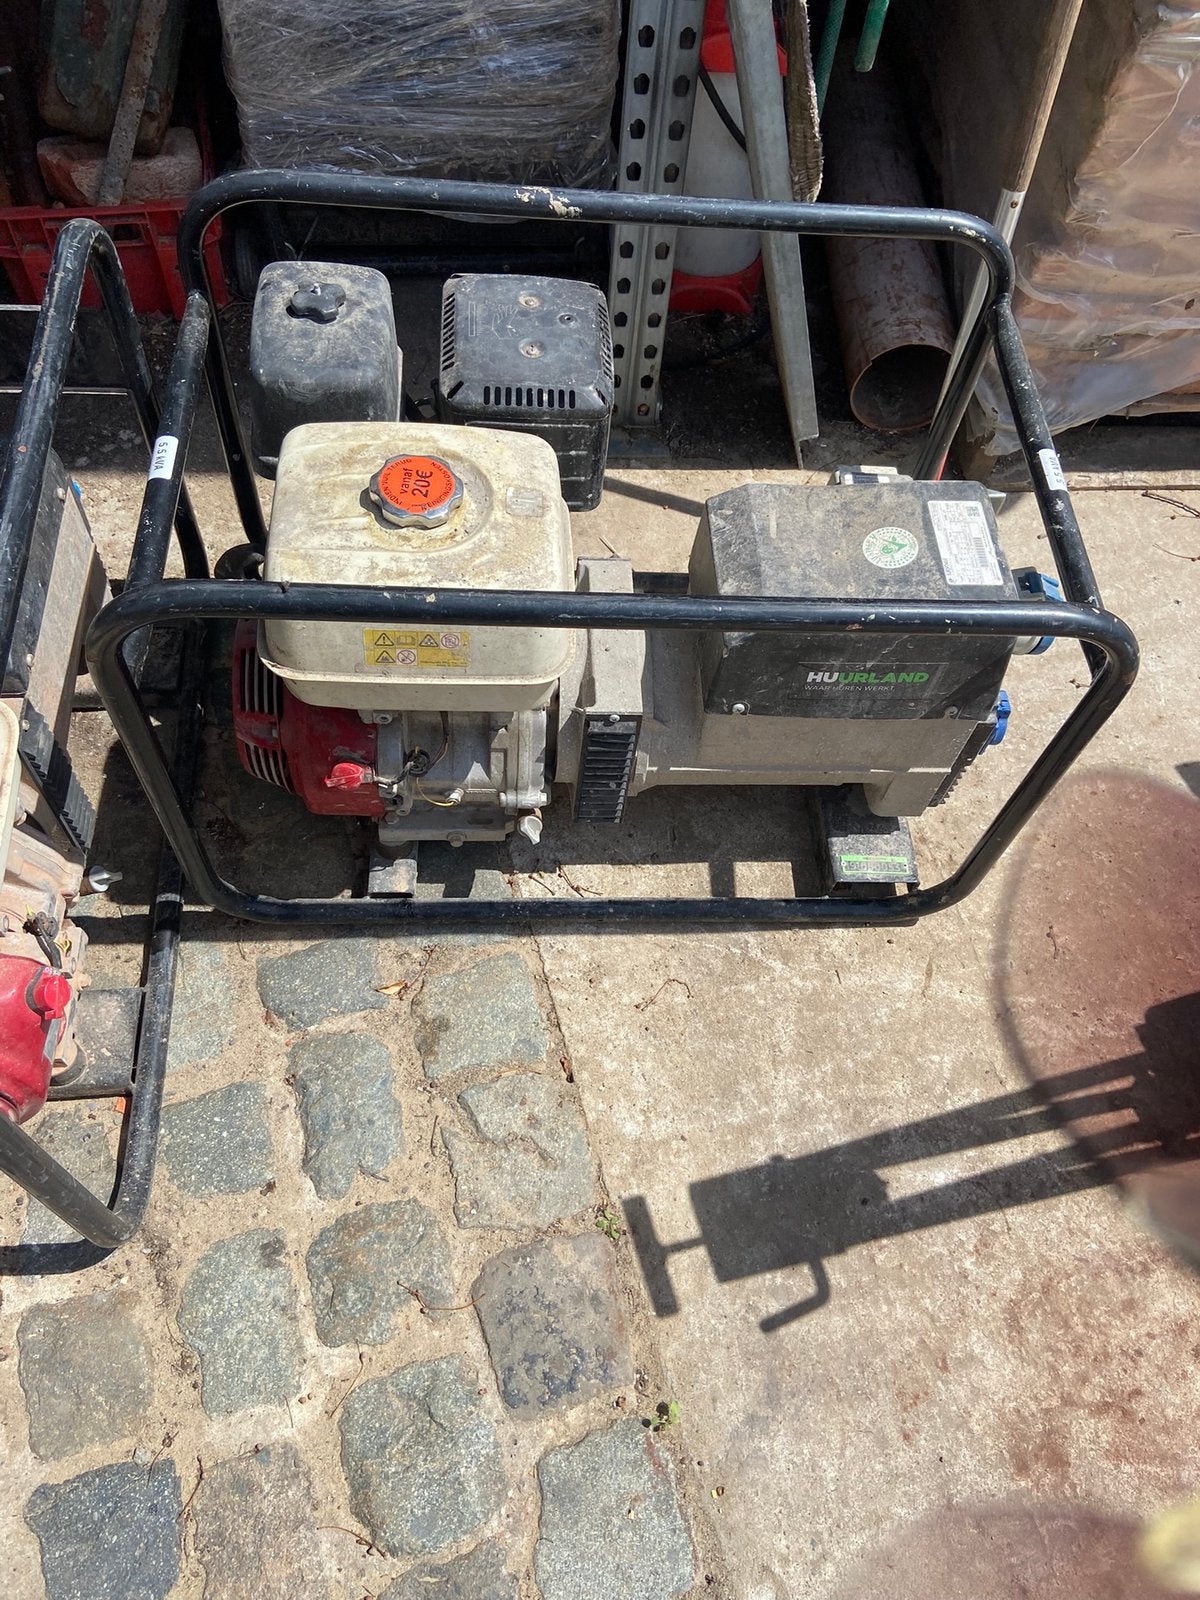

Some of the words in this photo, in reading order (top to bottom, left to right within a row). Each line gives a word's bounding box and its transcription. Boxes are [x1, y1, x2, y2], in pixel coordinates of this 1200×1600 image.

[400, 468, 413, 494] vanaf
[411, 470, 433, 498] 20€
[807, 672, 929, 683] HUURLAND
